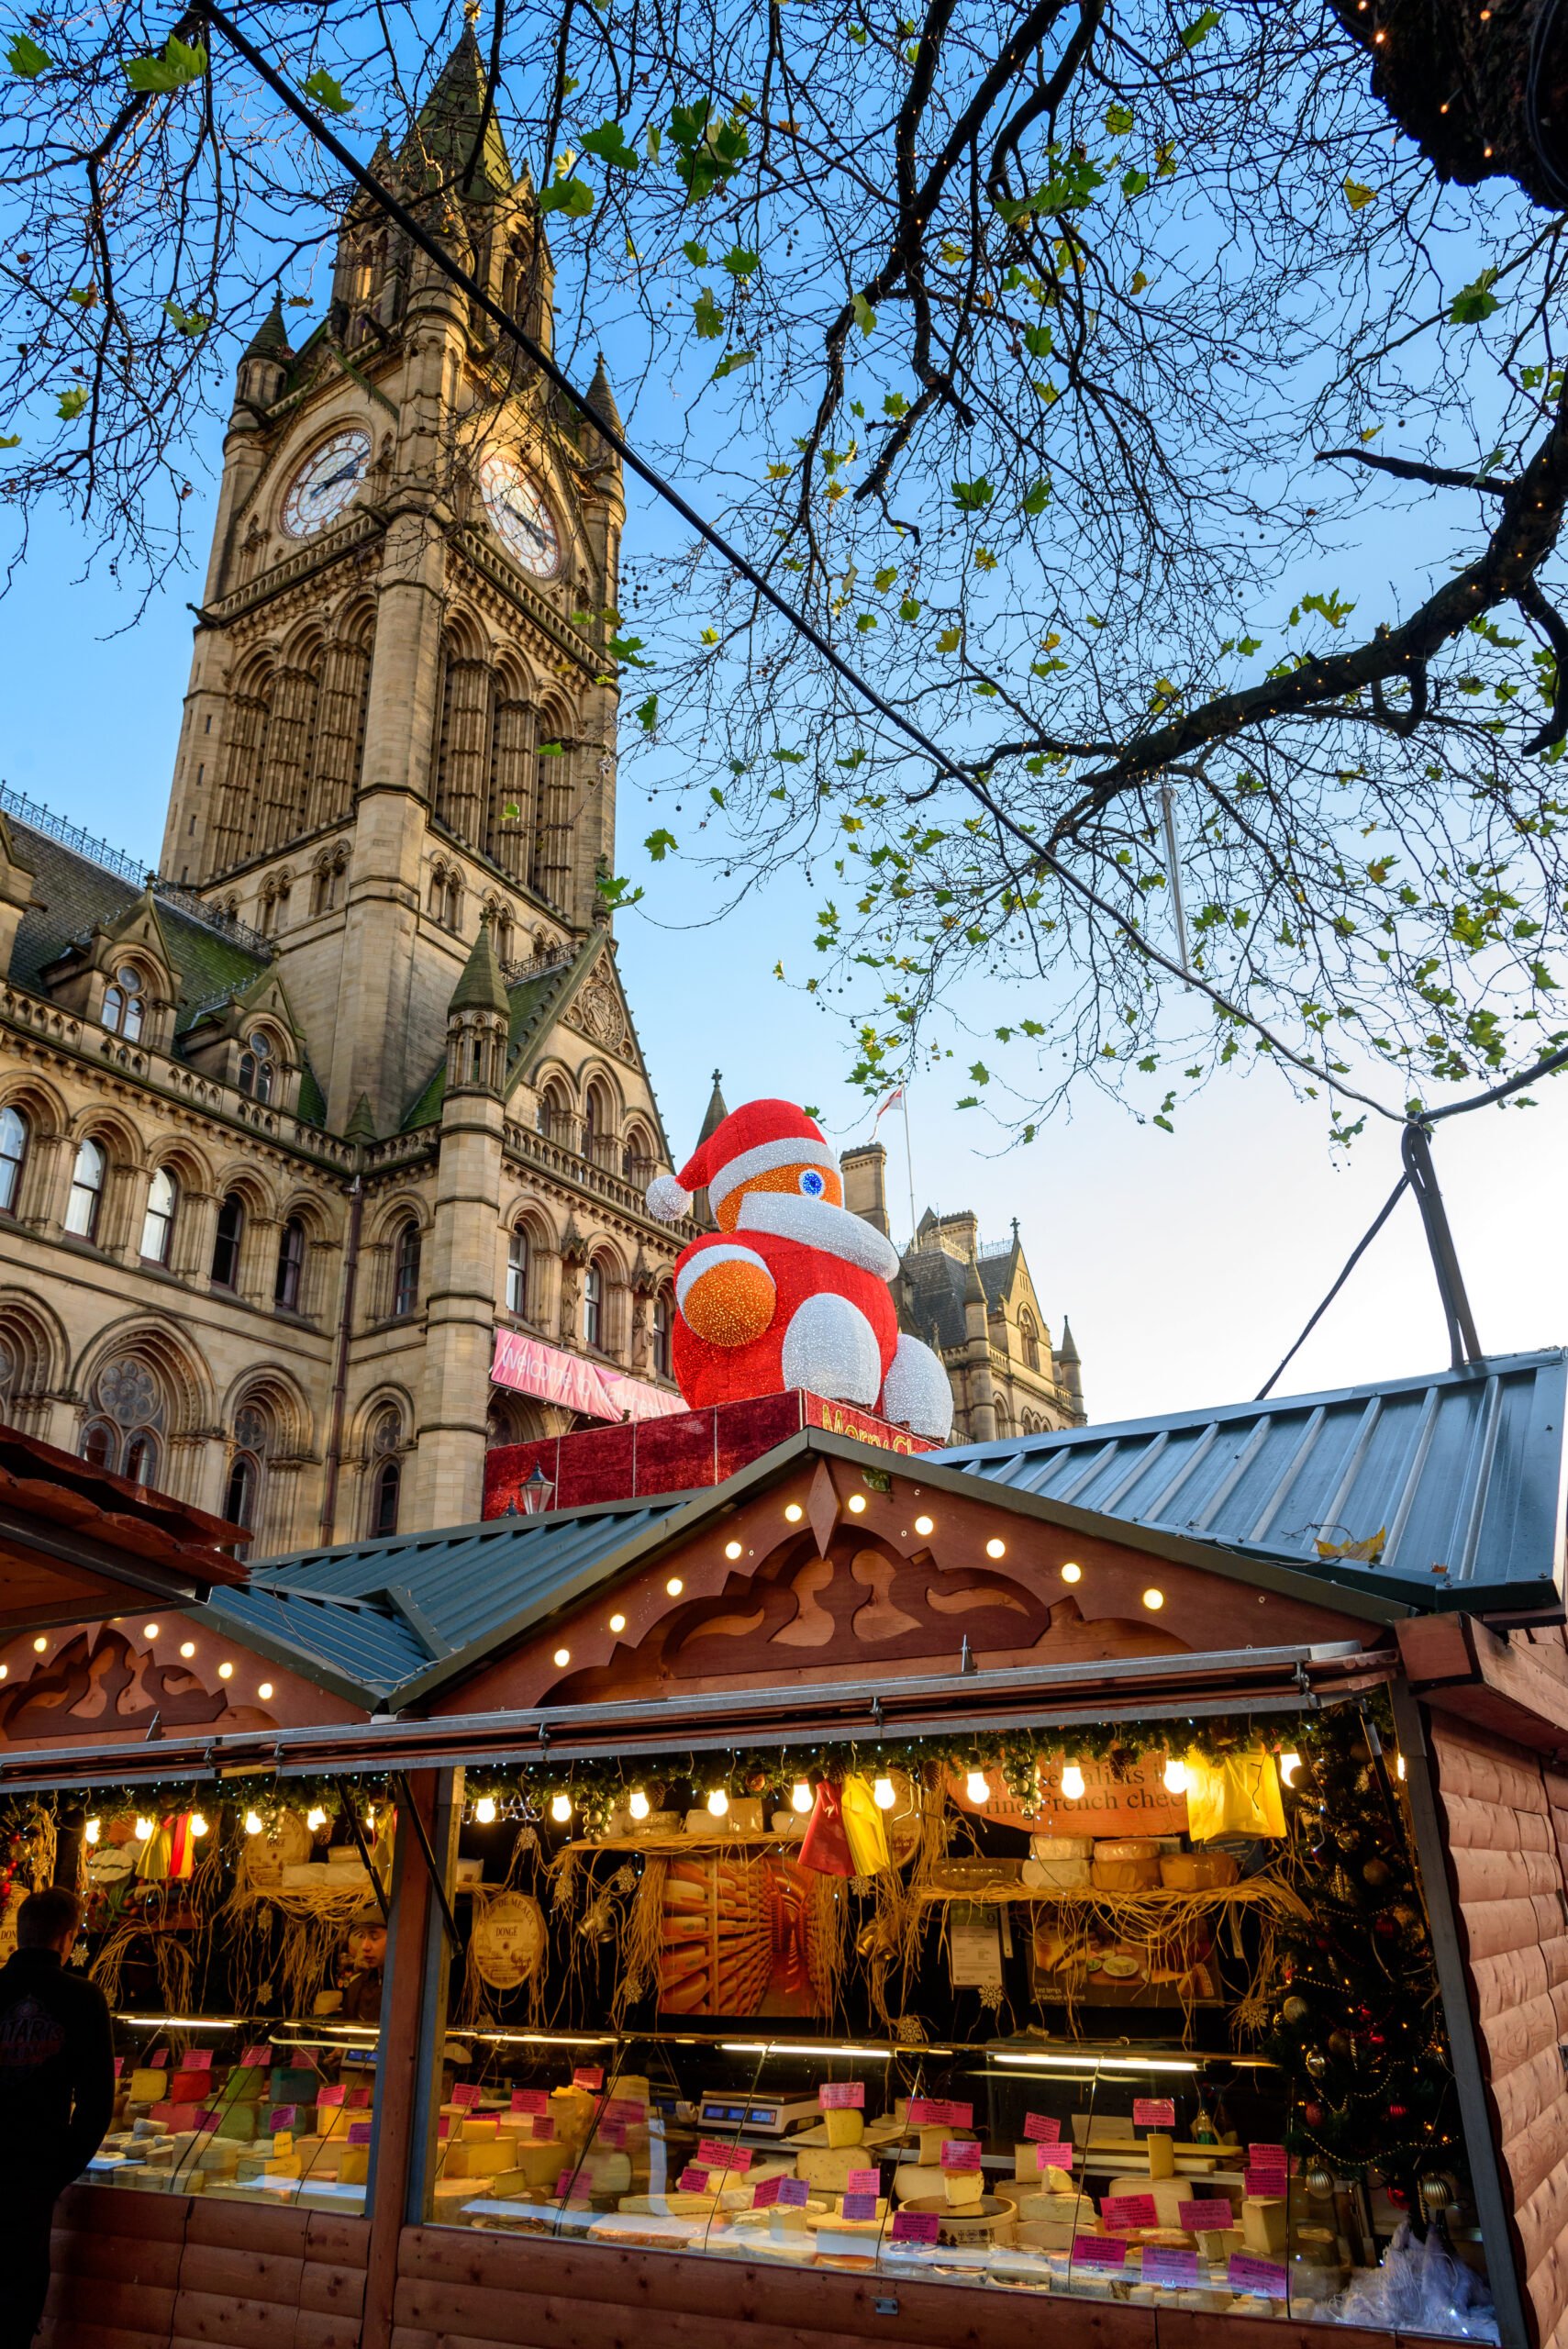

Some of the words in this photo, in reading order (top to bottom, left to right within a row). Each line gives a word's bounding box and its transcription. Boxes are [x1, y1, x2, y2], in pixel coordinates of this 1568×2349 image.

[502, 1345, 573, 1390] Welcome
[577, 1375, 592, 1396] to
[1038, 1789, 1118, 1812] French
